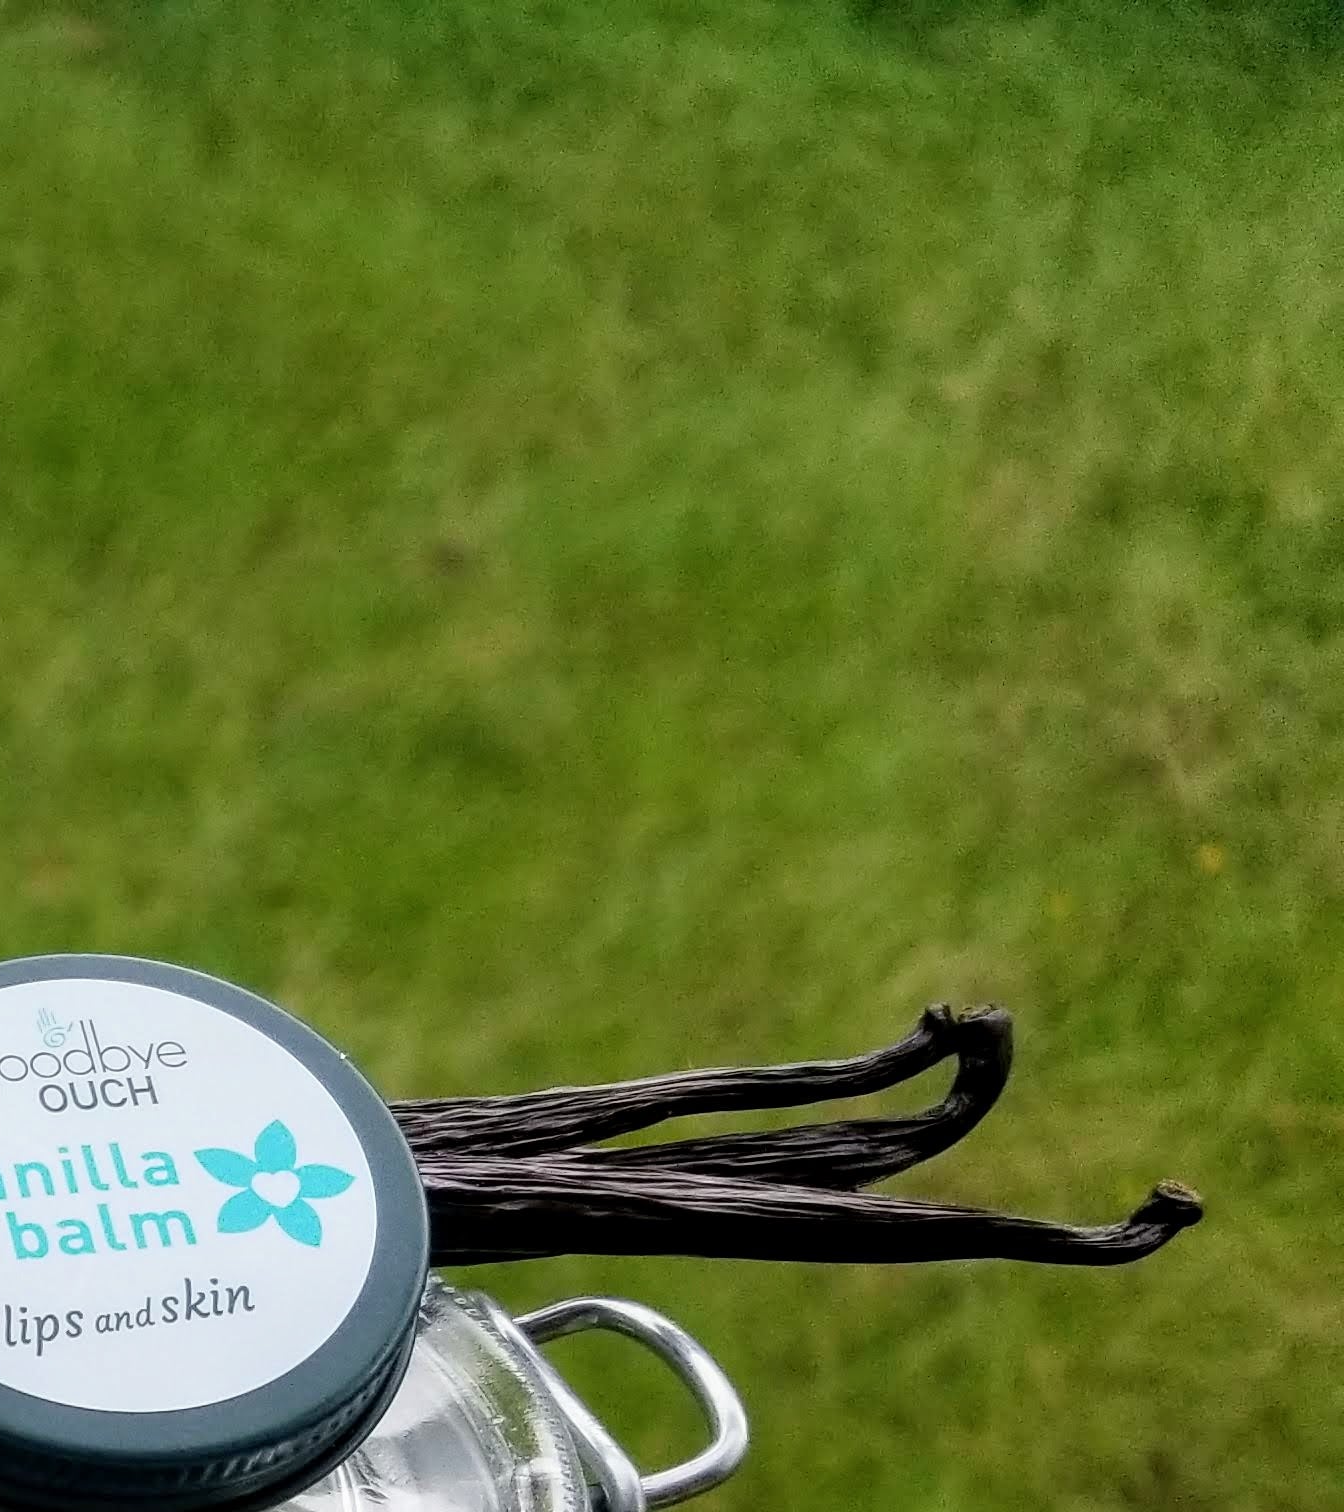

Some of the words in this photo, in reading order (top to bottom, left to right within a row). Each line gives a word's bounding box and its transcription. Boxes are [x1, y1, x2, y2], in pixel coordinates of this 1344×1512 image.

[39, 1074, 159, 1112] OUCH
[6, 1203, 197, 1260] balm
[5, 1304, 84, 1356] lips
[95, 1297, 155, 1333] and
[161, 1277, 255, 1323] skin
